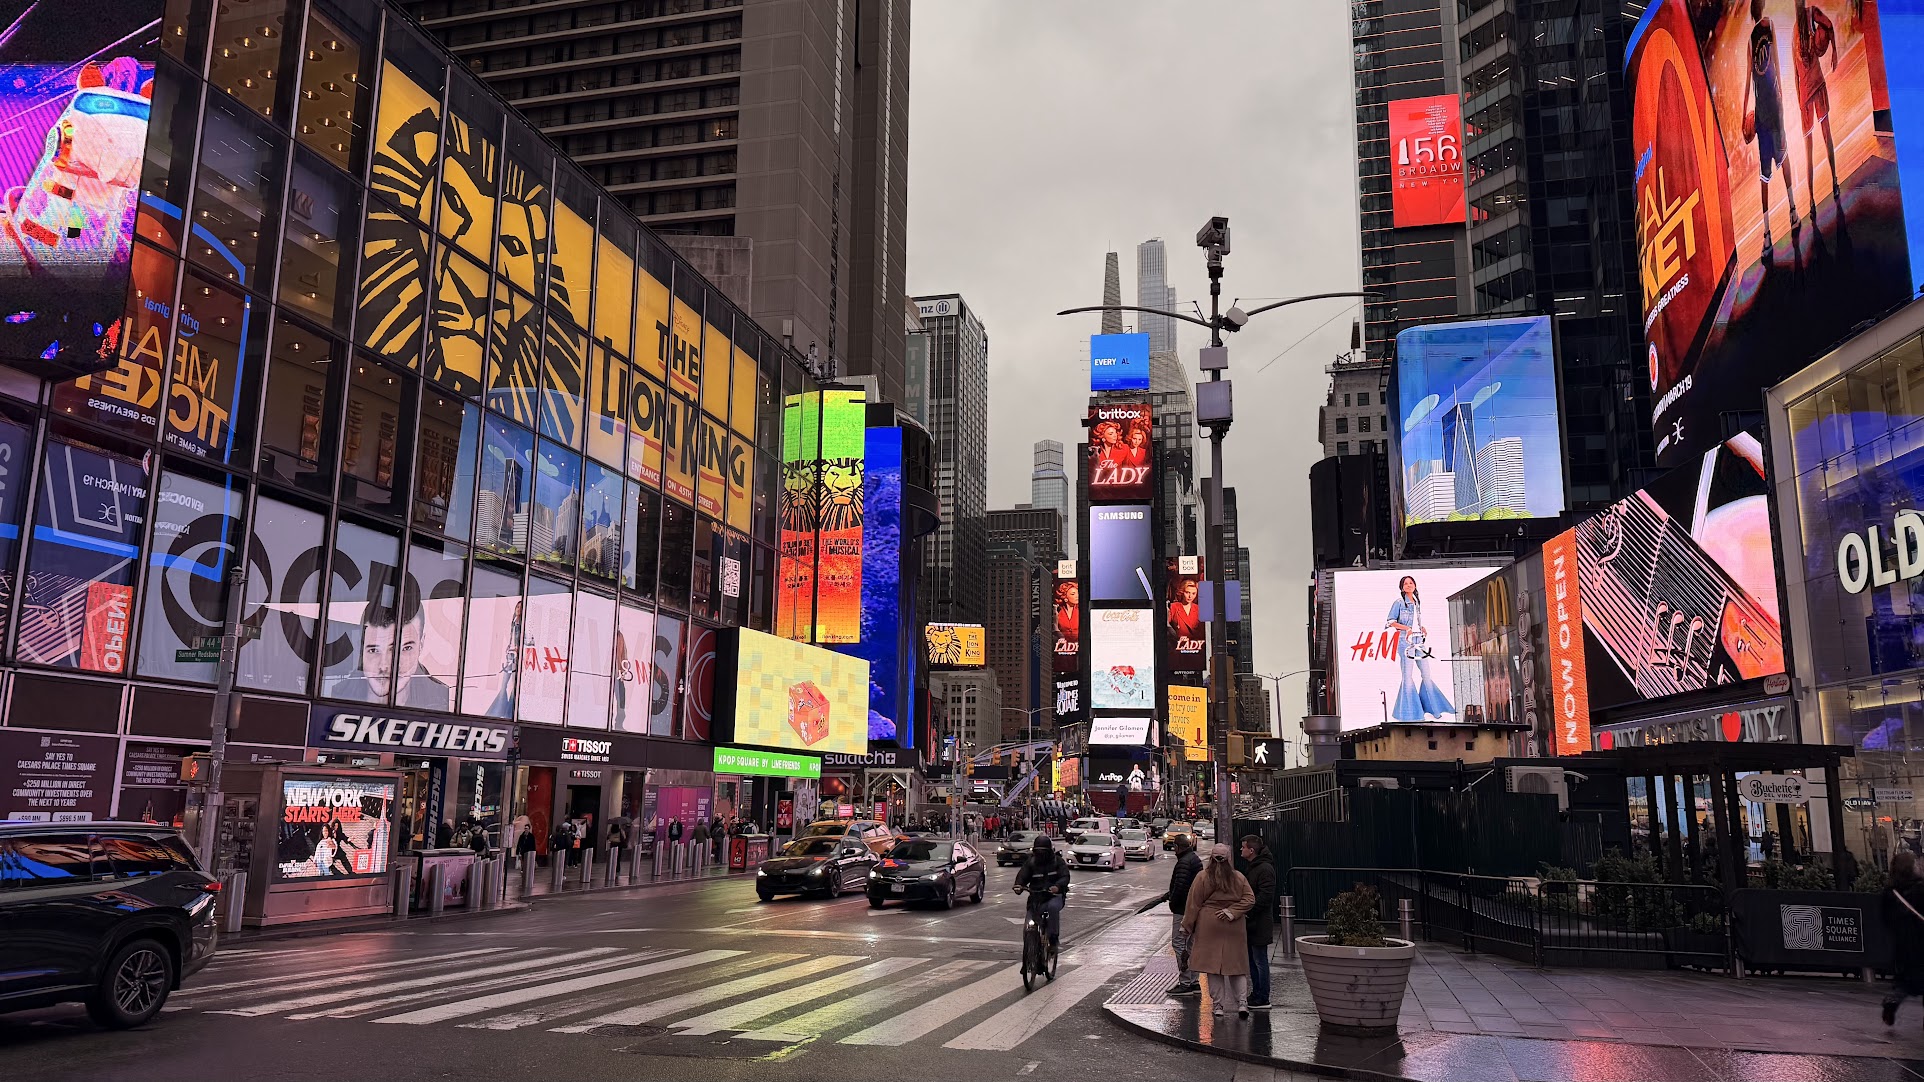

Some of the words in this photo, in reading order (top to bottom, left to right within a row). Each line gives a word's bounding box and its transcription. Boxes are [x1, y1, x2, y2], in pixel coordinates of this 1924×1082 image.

[1398, 135, 1462, 165] 156
[1398, 162, 1461, 176] BROADW
[1657, 273, 1689, 313] GREATNESS
[655, 319, 700, 384] THE
[1094, 358, 1116, 366] EVERY
[1684, 374, 1693, 391] 19
[600, 335, 678, 449] LION
[681, 391, 745, 489] KING
[1098, 408, 1141, 420] britbox
[1099, 459, 1118, 469] The
[1091, 467, 1149, 485] LADY
[631, 460, 661, 484] ENTRANCE
[667, 479, 677, 490] ON
[679, 484, 693, 499] 45TH
[698, 495, 714, 510] STREET
[1097, 511, 1144, 521] SAMSUNG
[828, 545, 860, 556] MUSICAL
[1838, 513, 1924, 594] OLD
[1182, 558, 1194, 566] brit
[1552, 545, 1574, 651] OPEN!
[206, 638, 215, 648] 44
[966, 640, 979, 649] LION
[1054, 642, 1079, 652] LADY
[1175, 640, 1206, 651] LADY
[1351, 630, 1400, 662] H&M
[198, 650, 220, 658] Redstone
[965, 648, 981, 658] KING
[1192, 694, 1201, 702] in
[1561, 658, 1581, 745] NOW
[1175, 703, 1186, 715] try
[327, 714, 509, 753] SKECHERS
[1168, 724, 1186, 737] today
[1613, 727, 1642, 750] NY
[576, 739, 612, 754] TISSOT
[45, 752, 55, 760] SAY
[56, 753, 66, 761] YES
[67, 753, 73, 761] TO
[718, 754, 735, 765] KPOP
[737, 756, 759, 768] SQUARE
[762, 758, 769, 769] BY
[771, 759, 782, 770] LINE
[782, 760, 801, 771] FRIENDS
[824, 751, 884, 765] swatch
[17, 760, 41, 770] CAESARS
[41, 761, 61, 770] PALACE
[61, 762, 77, 771] TIMES
[77, 762, 96, 771] SQUARE
[1098, 772, 1124, 783] ArtPop
[40, 780, 61, 788] MILLION
[1750, 779, 1793, 798] Buchette
[12, 788, 45, 797] COMMUNITY
[80, 790, 93, 798] OVER
[286, 787, 322, 807] NEW
[323, 787, 363, 807] YORK
[28, 798, 38, 806] THE
[39, 798, 53, 807] NEXT
[53, 799, 60, 807] 10
[60, 799, 77, 807] YEARS
[427, 766, 442, 849] SKECHER
[284, 806, 330, 823] STARTS
[332, 807, 361, 823] HERE
[1828, 916, 1855, 926] TIMES
[1825, 926, 1858, 935] SQUARE
[1828, 935, 1857, 943] ALLIANCE
